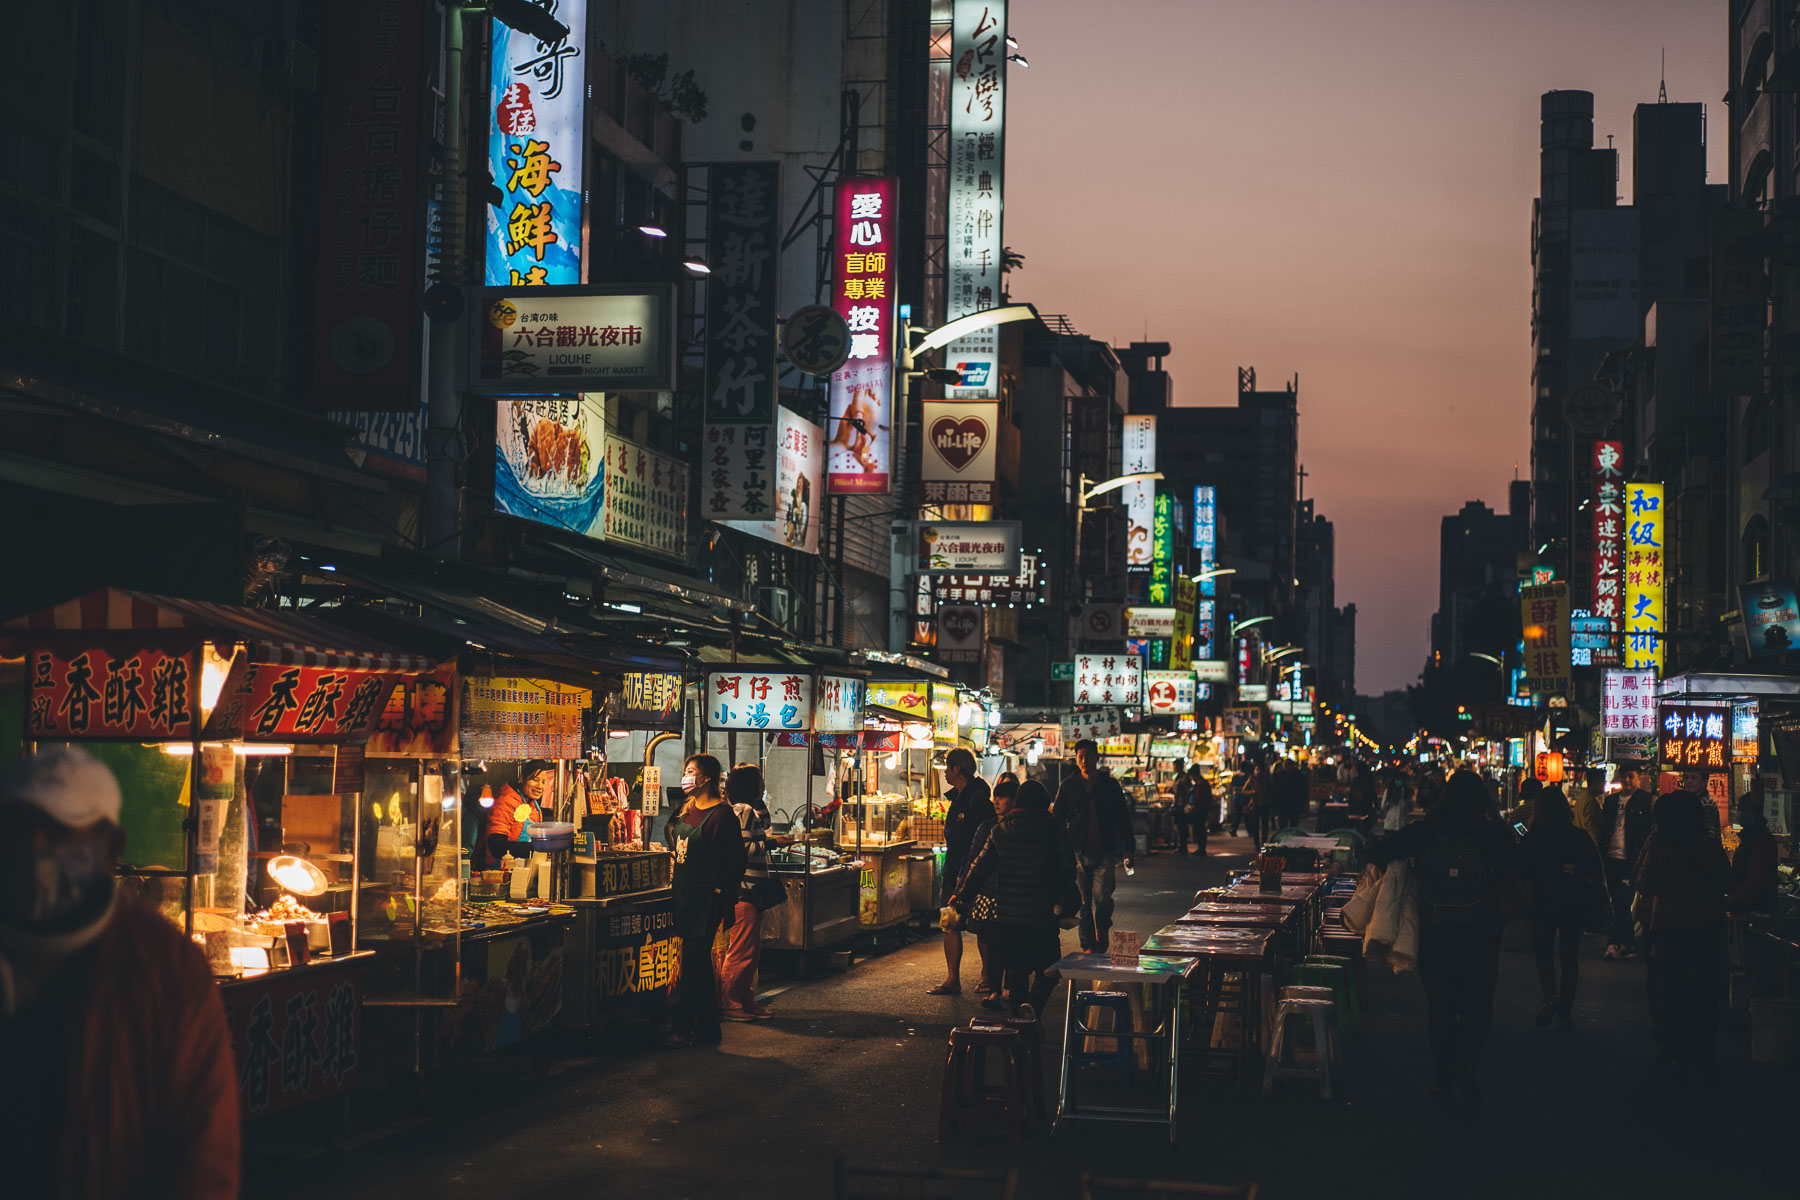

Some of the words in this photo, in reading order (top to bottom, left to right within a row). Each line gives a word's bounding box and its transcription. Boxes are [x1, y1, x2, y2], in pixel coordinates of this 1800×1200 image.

[967, 7, 999, 121] 台灣
[503, 84, 535, 136] 生猛
[956, 139, 964, 182] TAIWAN
[850, 192, 882, 245] 愛心
[844, 278, 886, 300] 專業
[845, 252, 887, 274] 盲師
[711, 168, 771, 416] 達新茶行
[513, 325, 643, 347] 六合觀光夜市
[789, 313, 841, 365] 茶
[848, 306, 881, 359] 按摩
[549, 354, 592, 365] LIOUHE
[584, 367, 609, 375] NIGHT
[612, 366, 645, 375] MARKET
[708, 427, 736, 444] 台灣
[937, 428, 982, 456] Hi-Life
[710, 446, 731, 512] 名家壺
[740, 426, 768, 514] 阿里山茶
[924, 482, 992, 502] 萊爾富
[1629, 489, 1661, 548] 和級
[936, 542, 1005, 554] 六合觀光夜市
[32, 653, 58, 731] 豆乳
[60, 653, 191, 735] 香酥雞
[251, 667, 384, 737] 香酥雞
[716, 675, 804, 702] 蚵仔煎
[1078, 690, 1139, 704] 廣東粥
[1621, 676, 1639, 729] 鳳梨酥
[1641, 676, 1658, 729] 牛軋餅
[714, 703, 803, 728] 小湯包
[1070, 710, 1118, 726] 阿里山茶
[240, 980, 358, 1112] 香酥雞
